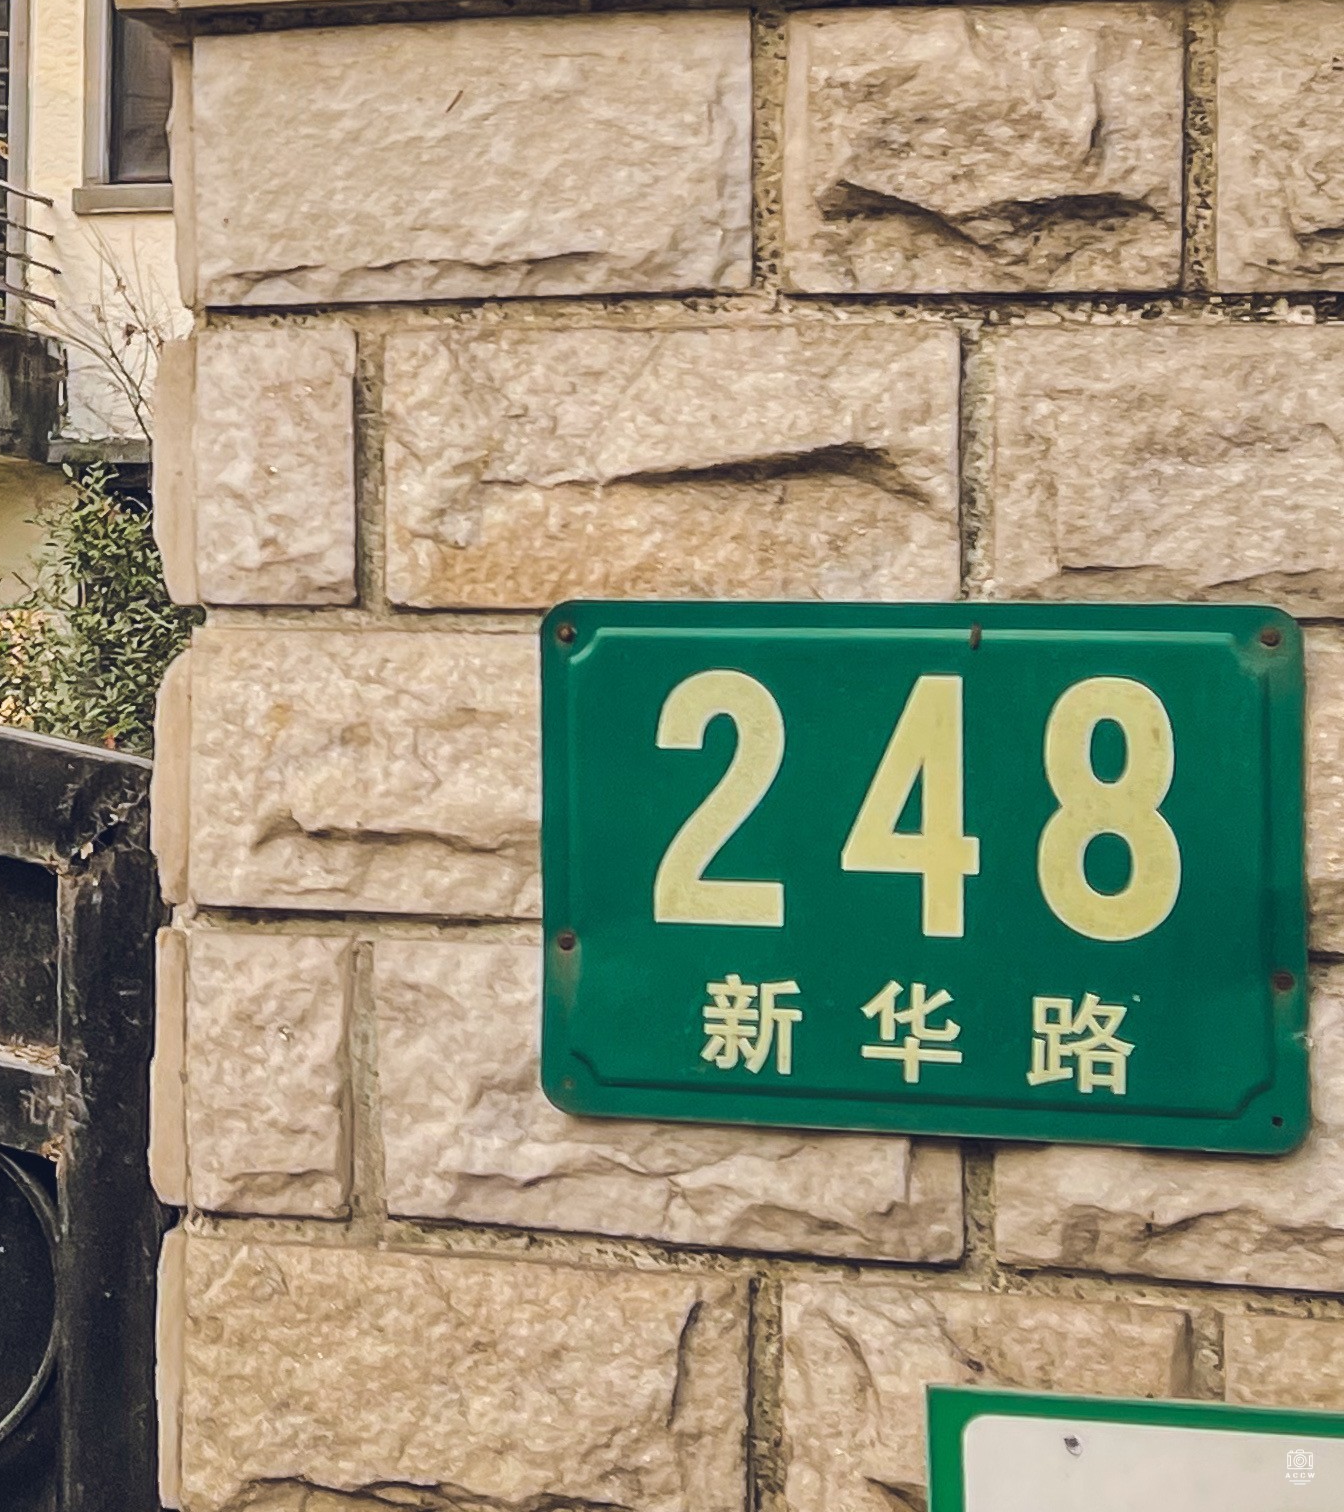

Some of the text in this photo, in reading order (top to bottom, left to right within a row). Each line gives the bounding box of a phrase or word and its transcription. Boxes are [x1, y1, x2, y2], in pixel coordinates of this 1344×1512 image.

[653, 669, 1183, 943] 248
[699, 973, 1136, 1095] 新华路
